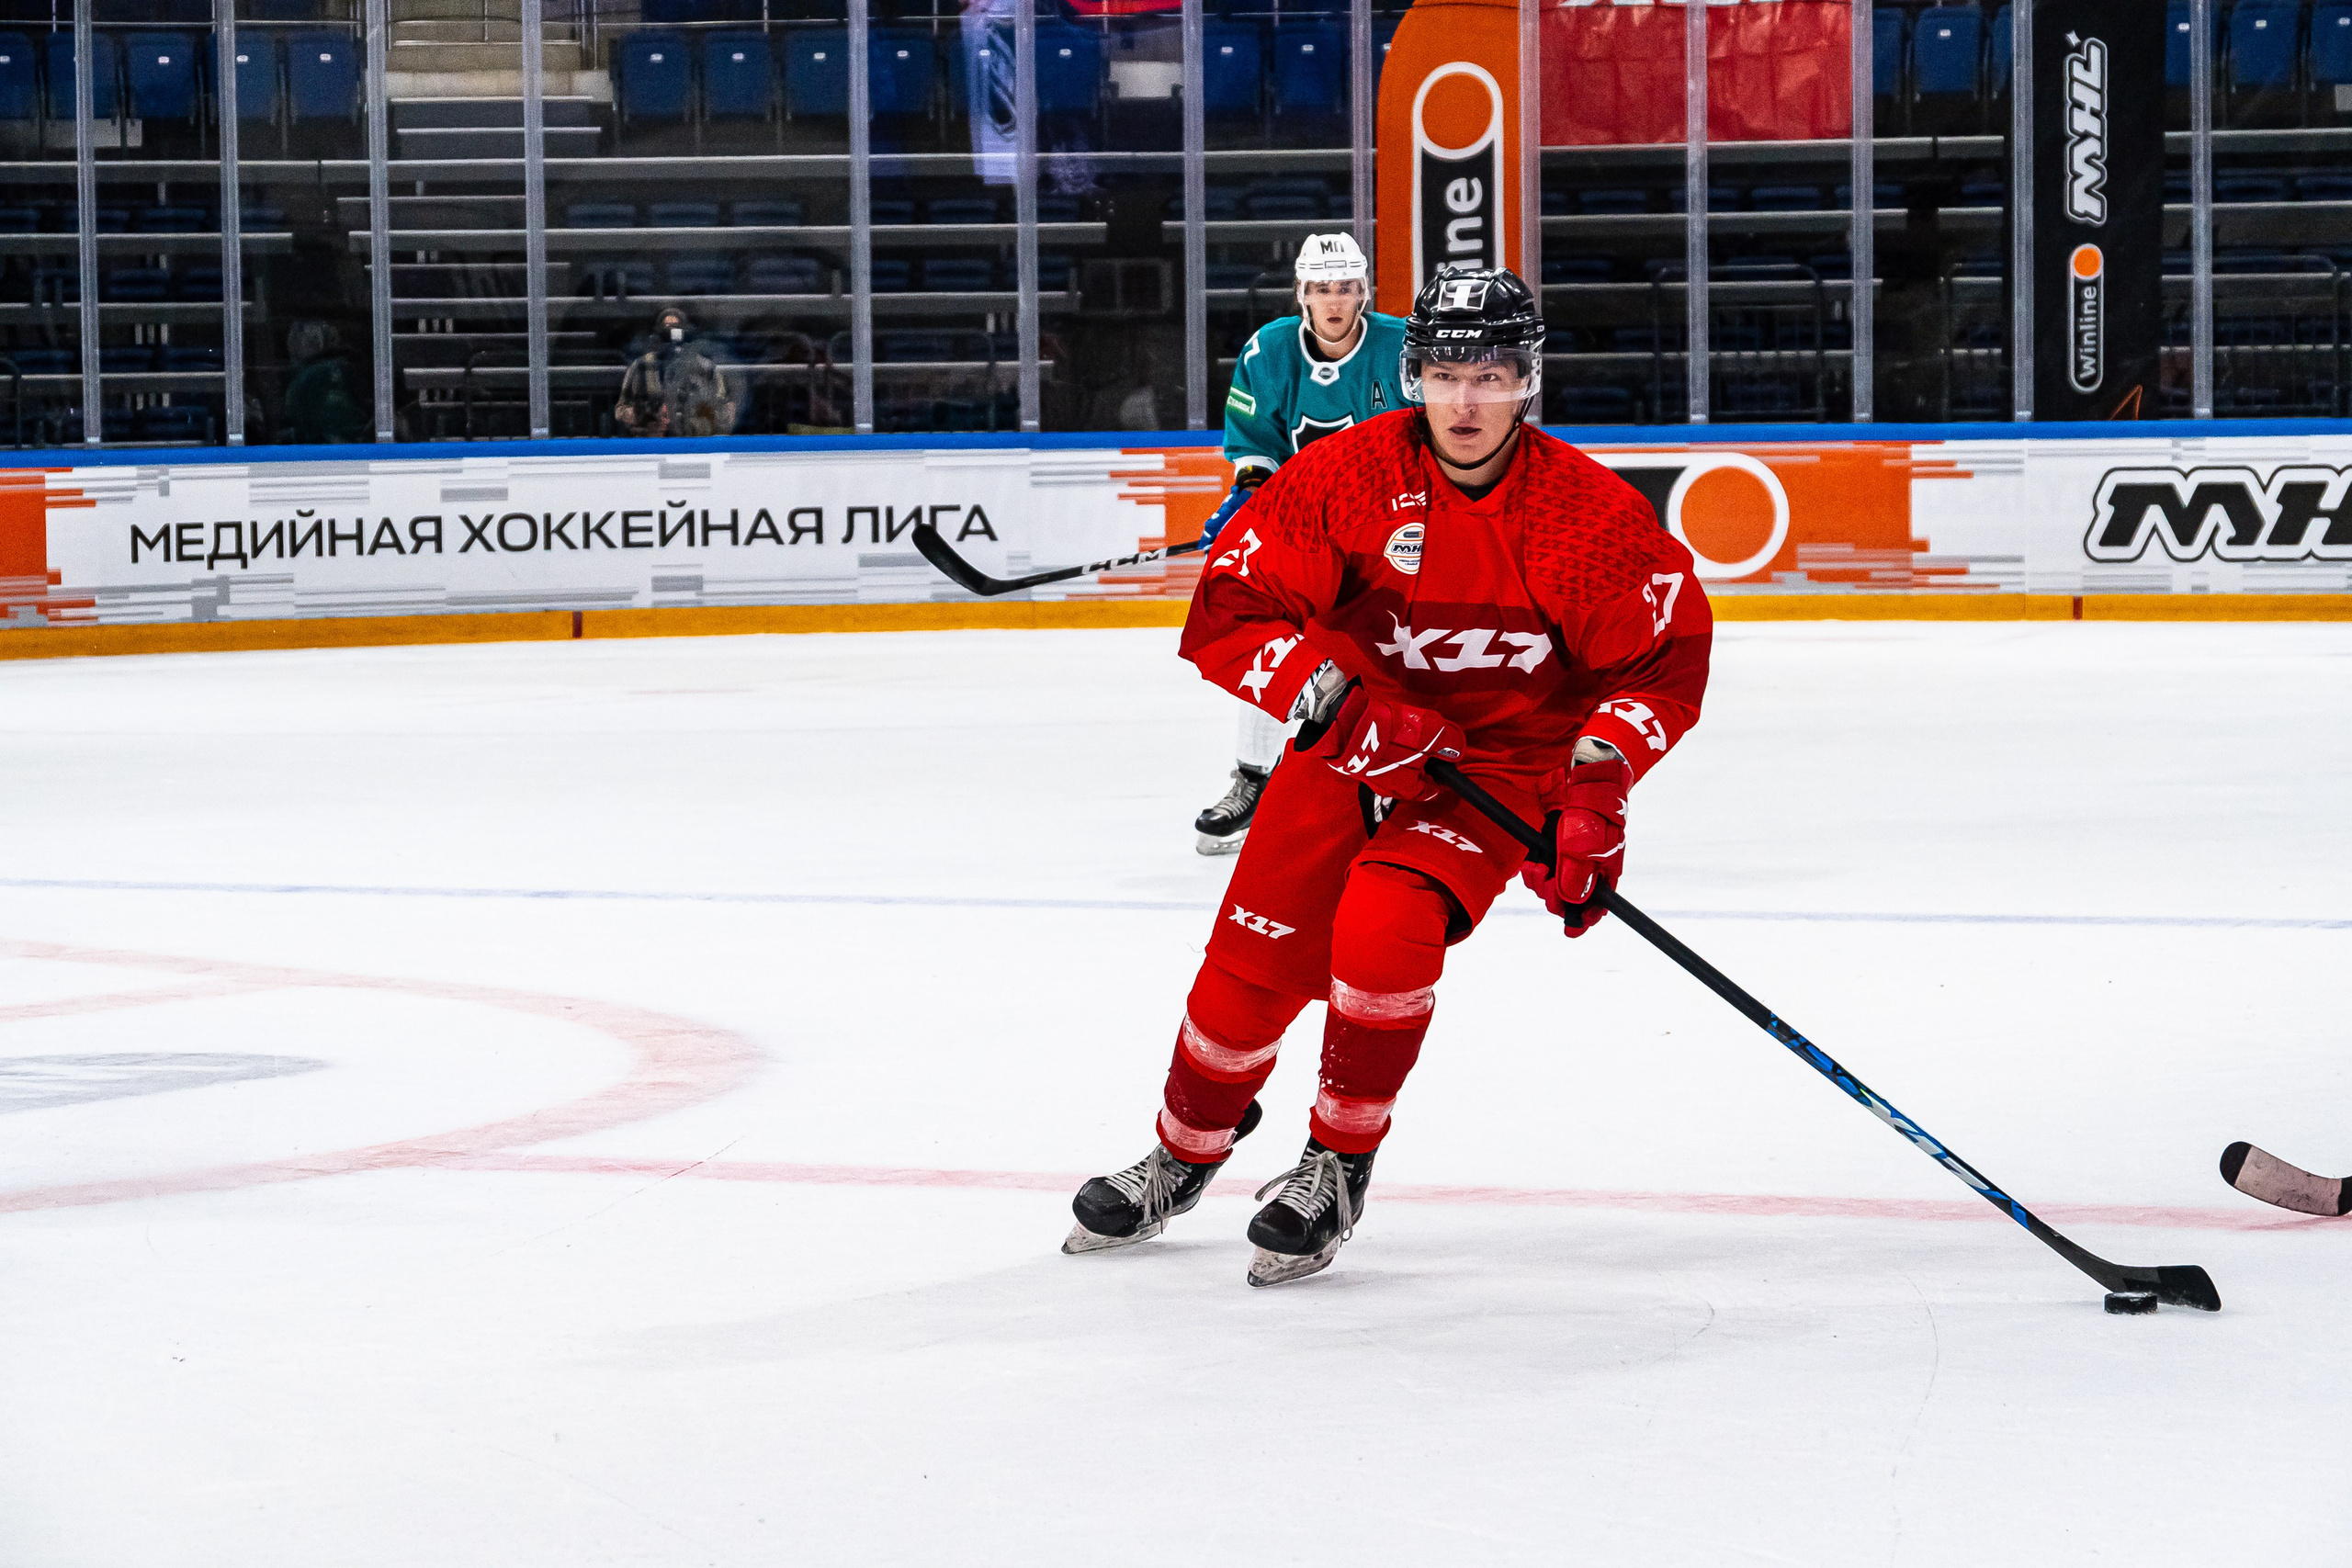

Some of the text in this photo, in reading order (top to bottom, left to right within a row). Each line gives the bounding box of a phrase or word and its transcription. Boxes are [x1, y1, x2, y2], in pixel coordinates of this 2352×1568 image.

[2064, 37, 2108, 228] MHL
[1436, 330, 1482, 338] CCM
[1371, 379, 1387, 410] A
[130, 499, 998, 570] МЕДИЙНАЯ ХОККЕЙНАЯ ЛИГА
[1392, 543, 1421, 554] MH
[1374, 610, 1553, 674] X17
[1407, 820, 1483, 853] X17
[1228, 904, 1296, 940] X17
